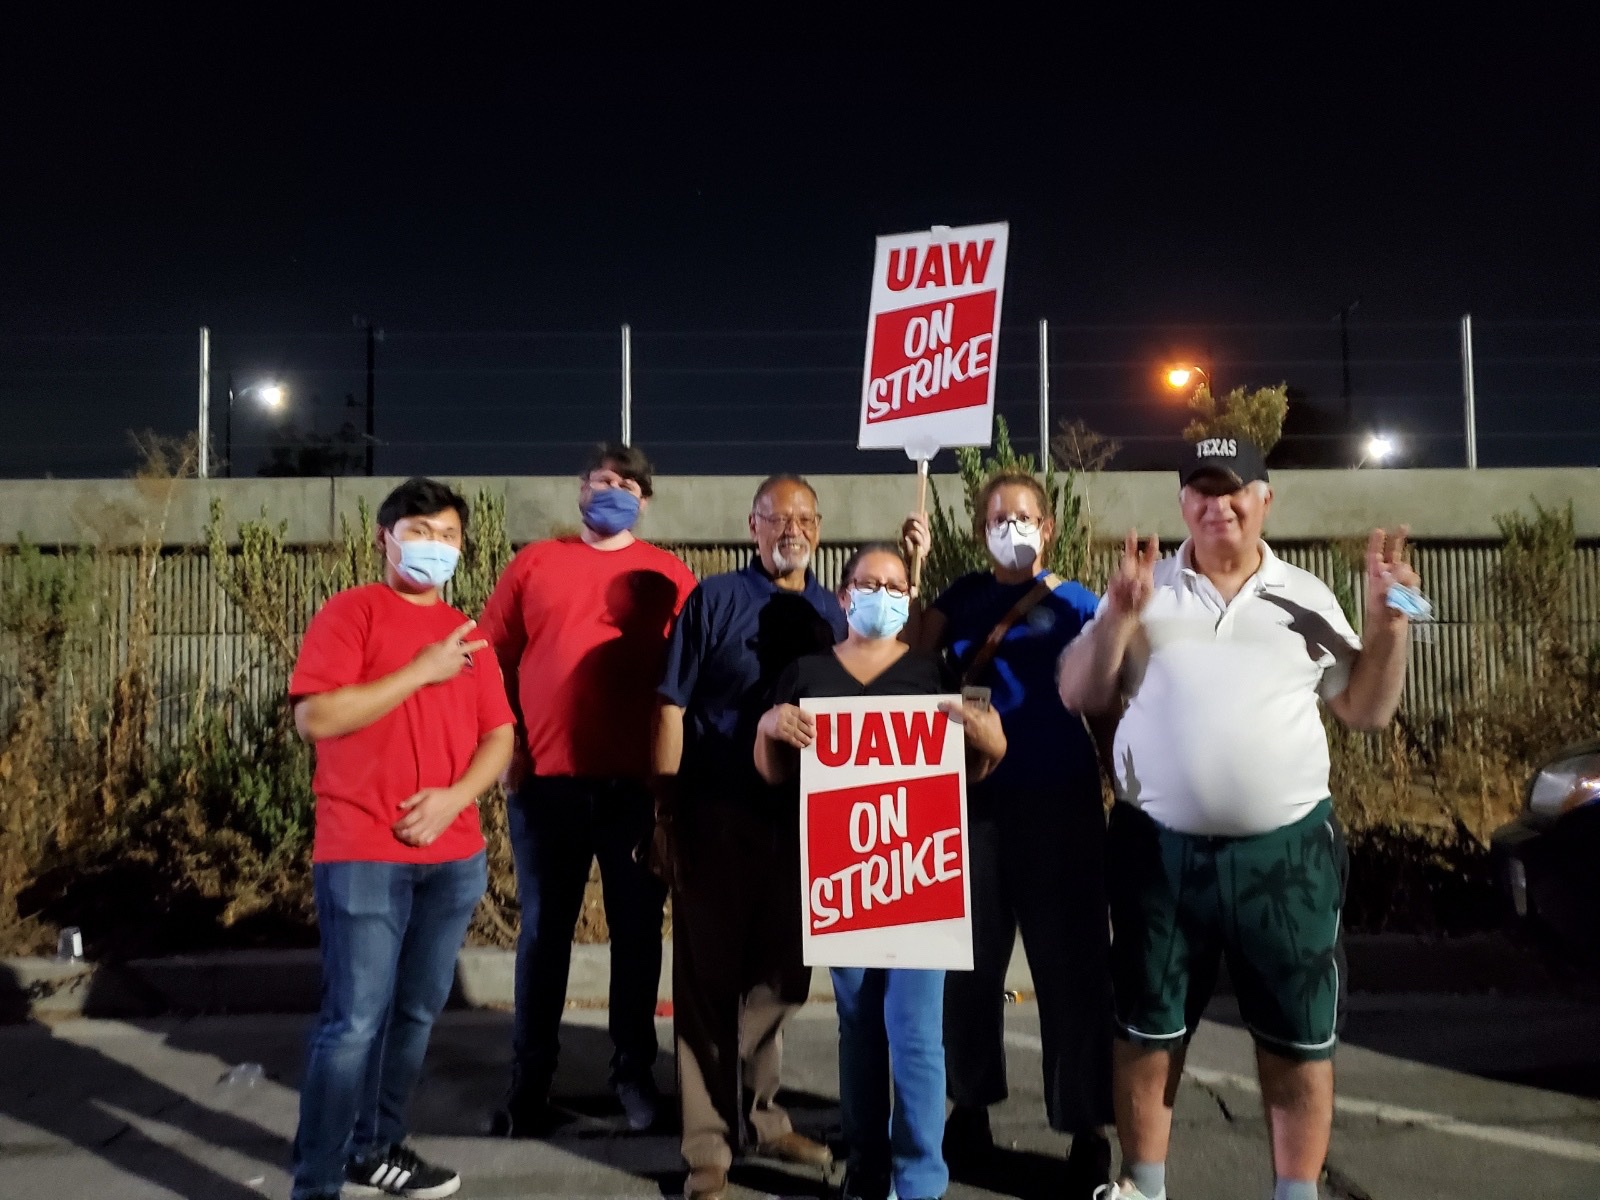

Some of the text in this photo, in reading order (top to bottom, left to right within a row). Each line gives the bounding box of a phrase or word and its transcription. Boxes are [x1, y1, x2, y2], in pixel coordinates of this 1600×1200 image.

[887, 238, 995, 291] UAW
[904, 302, 955, 358] ON
[868, 333, 992, 420] STRIKE
[1196, 438, 1237, 458] TEXAS
[815, 711, 949, 767] UAW
[850, 786, 908, 853] ON
[811, 827, 962, 929] STRIKE
